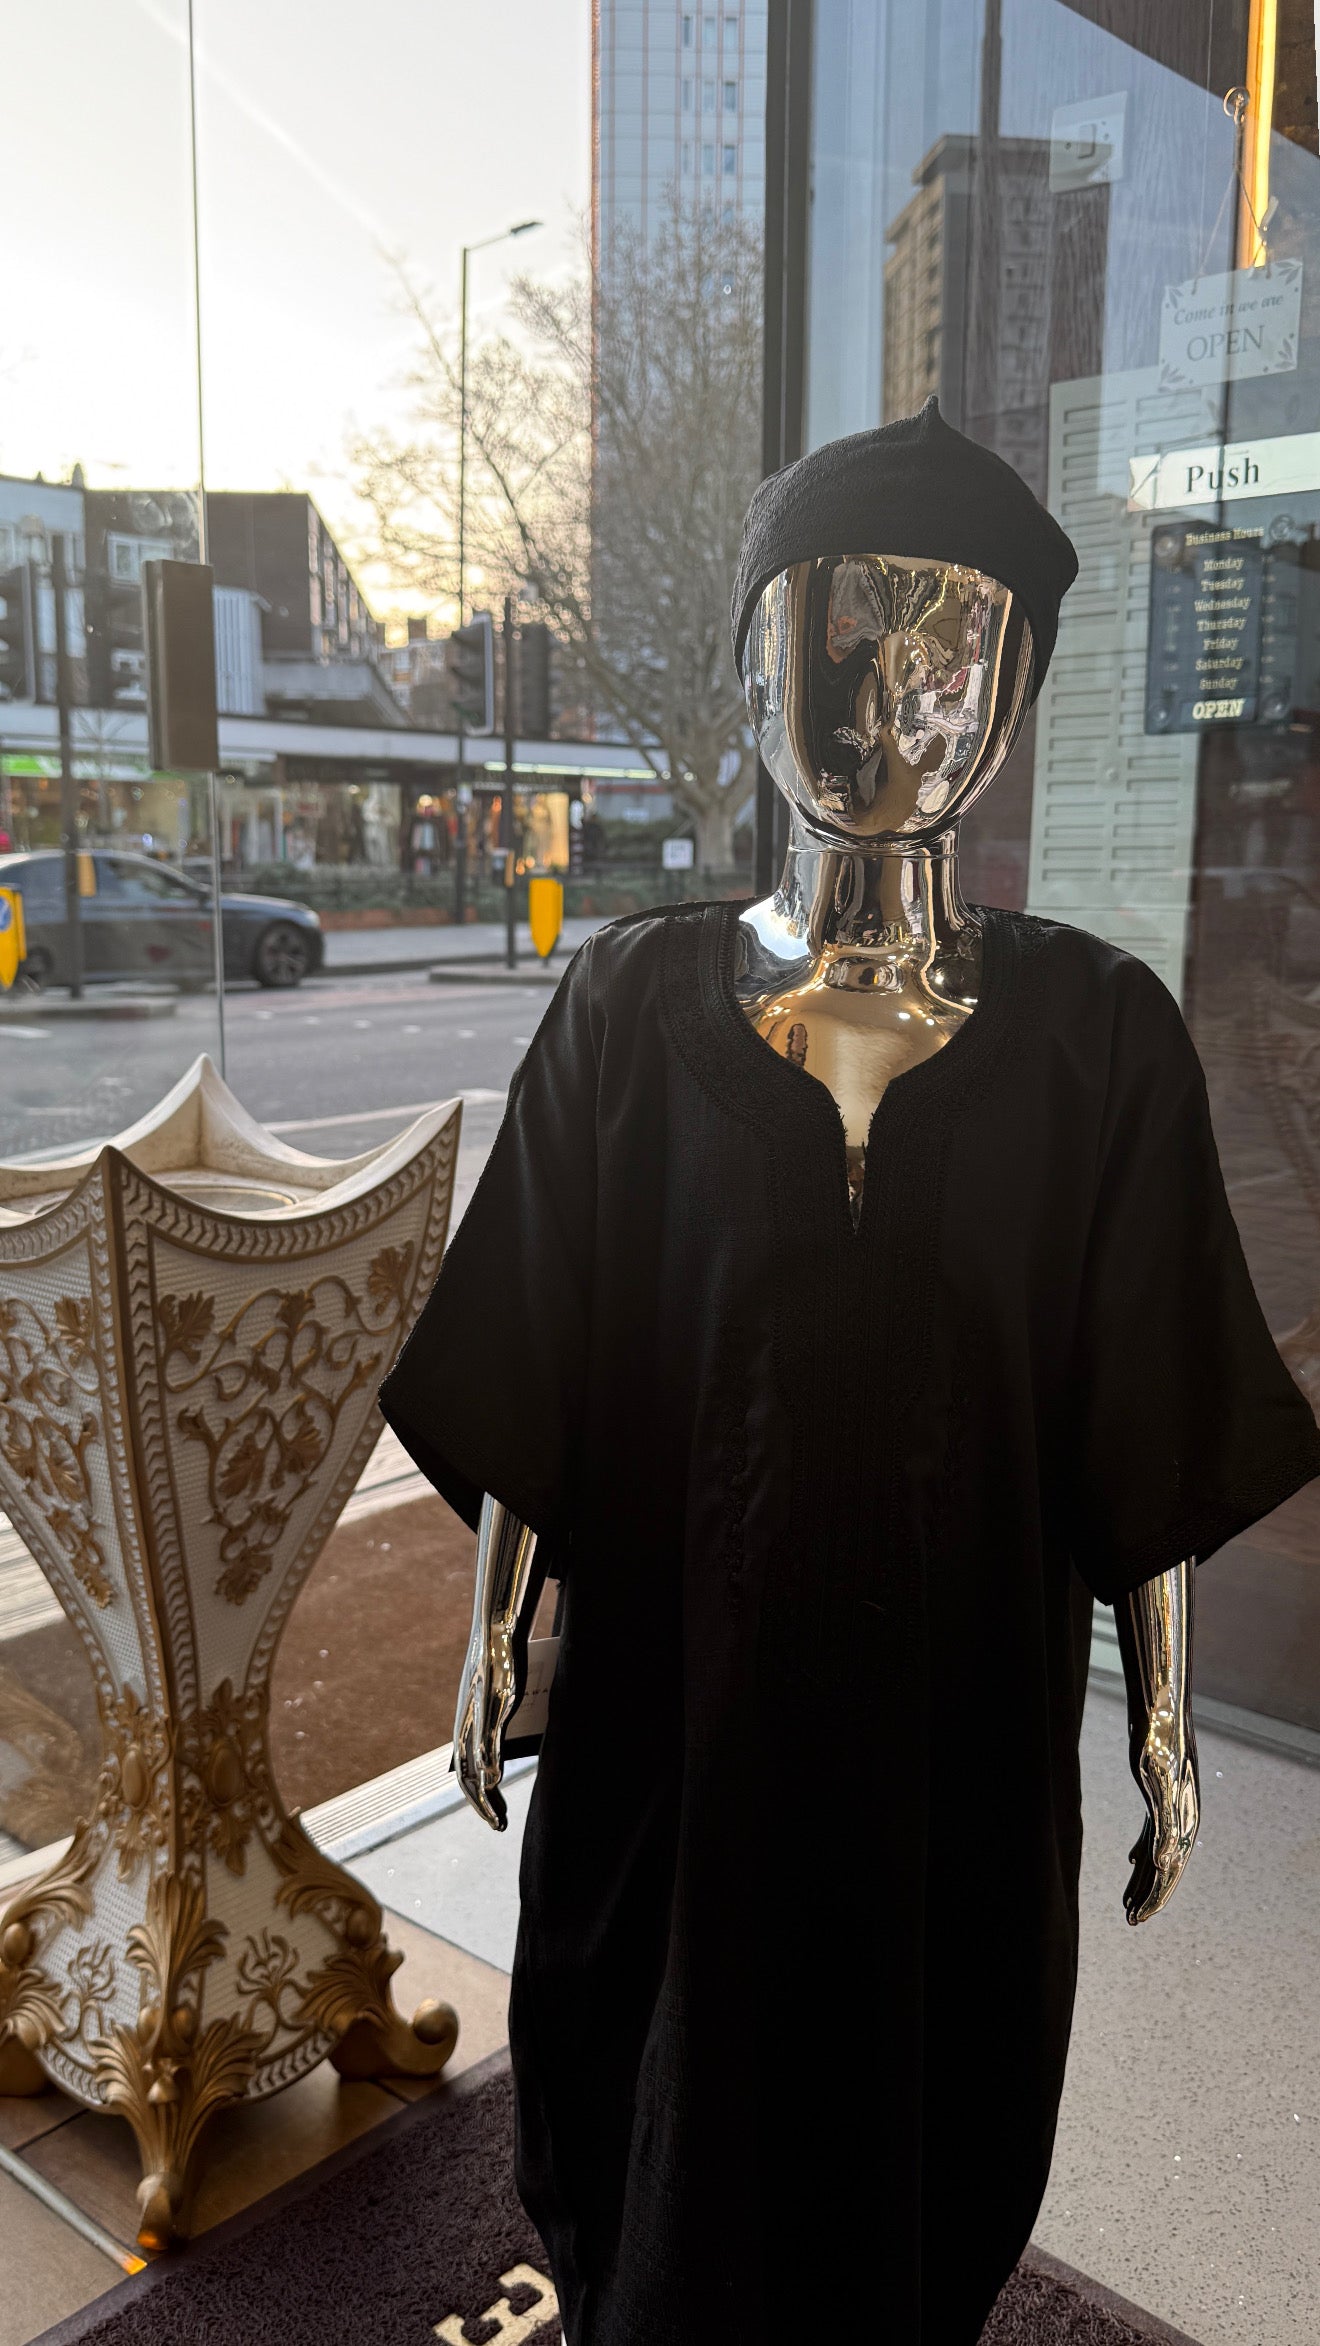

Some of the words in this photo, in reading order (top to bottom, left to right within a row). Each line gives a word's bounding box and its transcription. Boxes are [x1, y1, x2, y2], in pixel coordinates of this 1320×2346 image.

[1174, 305, 1215, 326] Come
[1239, 300, 1259, 313] we
[1261, 295, 1284, 309] are
[1187, 325, 1265, 361] OPEN
[1186, 457, 1260, 493] Push
[1185, 531, 1231, 547] Business
[1232, 527, 1265, 541] Hours
[1203, 557, 1244, 572] Monday
[1200, 577, 1245, 592] Tuesday
[1194, 597, 1251, 612] Wednesday
[1196, 617, 1247, 632] Thursday
[1203, 638, 1239, 651] Friday
[1195, 656, 1244, 671] Saturday
[1199, 677, 1239, 690] Sunday
[1192, 698, 1246, 720] OPEN
